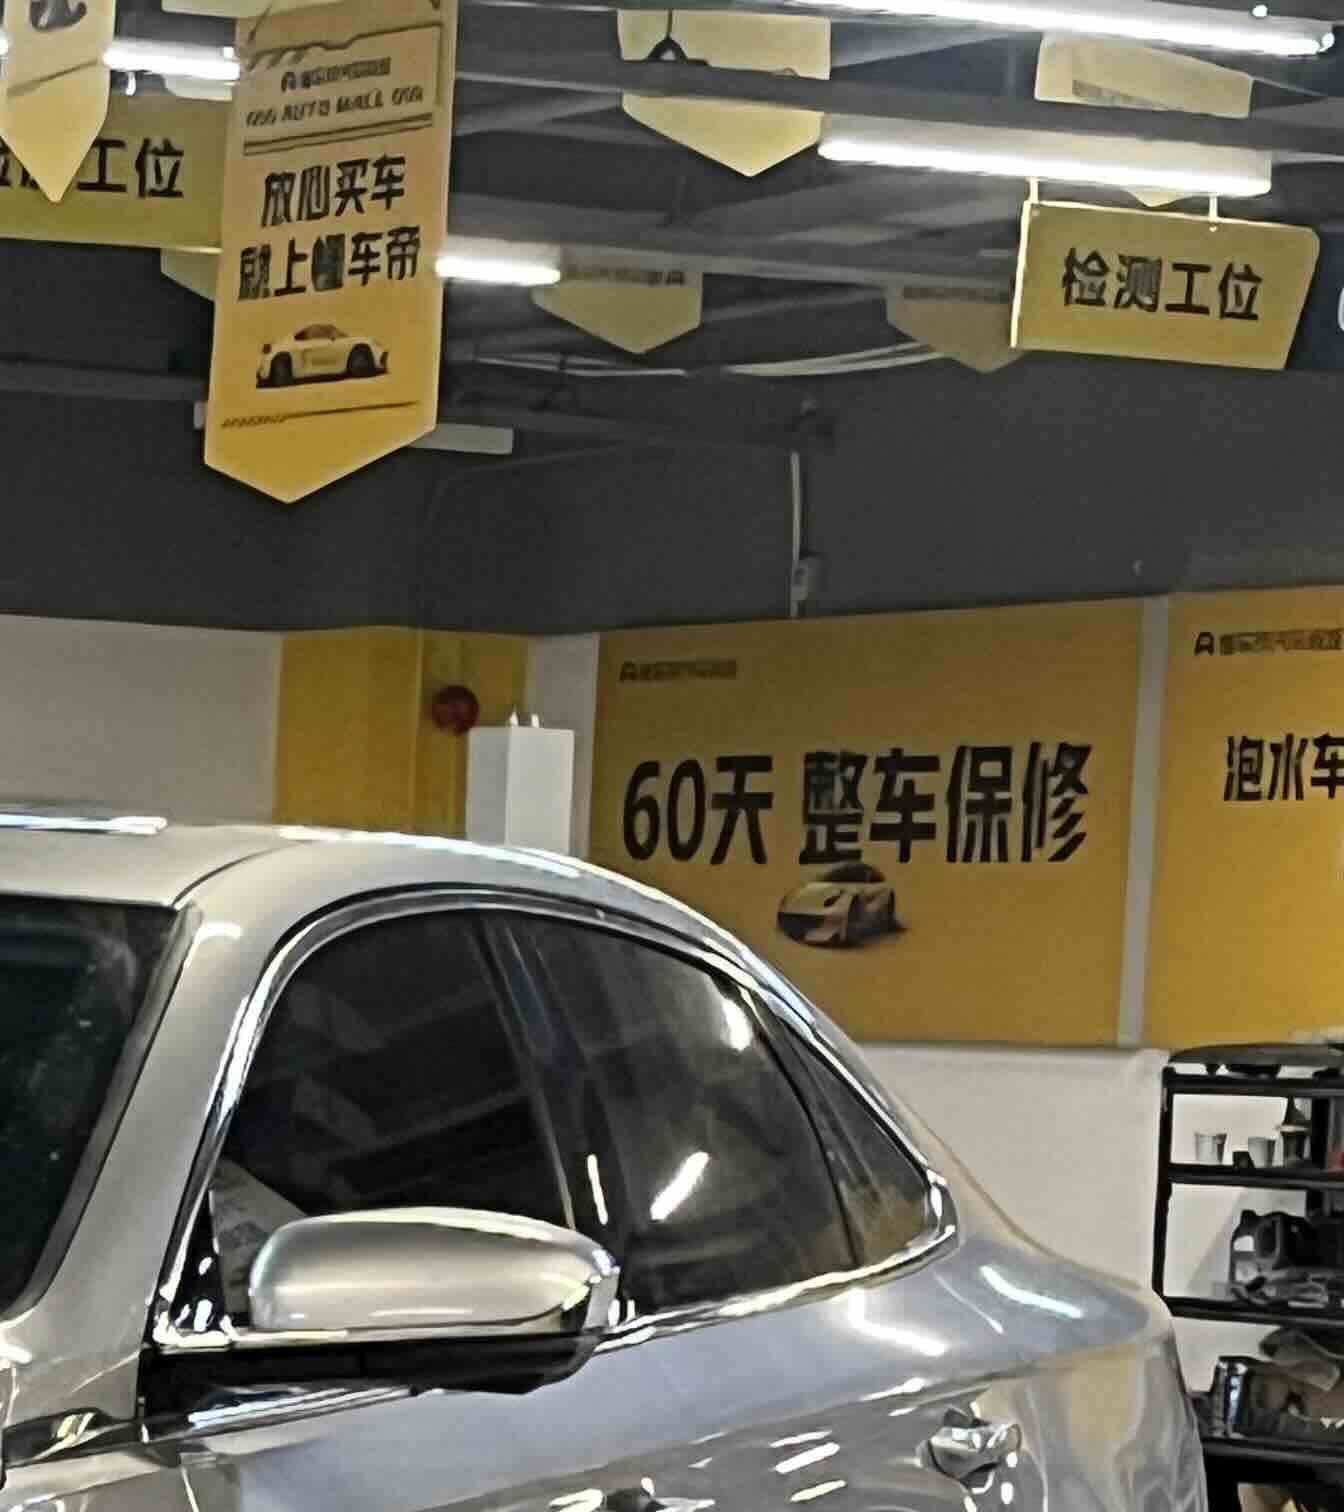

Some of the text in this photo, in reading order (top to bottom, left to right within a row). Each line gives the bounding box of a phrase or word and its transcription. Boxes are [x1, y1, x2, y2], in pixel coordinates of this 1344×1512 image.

[261, 154, 406, 227] 放心买车
[1062, 247, 1263, 321] 检测工位
[624, 742, 1092, 865] 60天 整车保修
